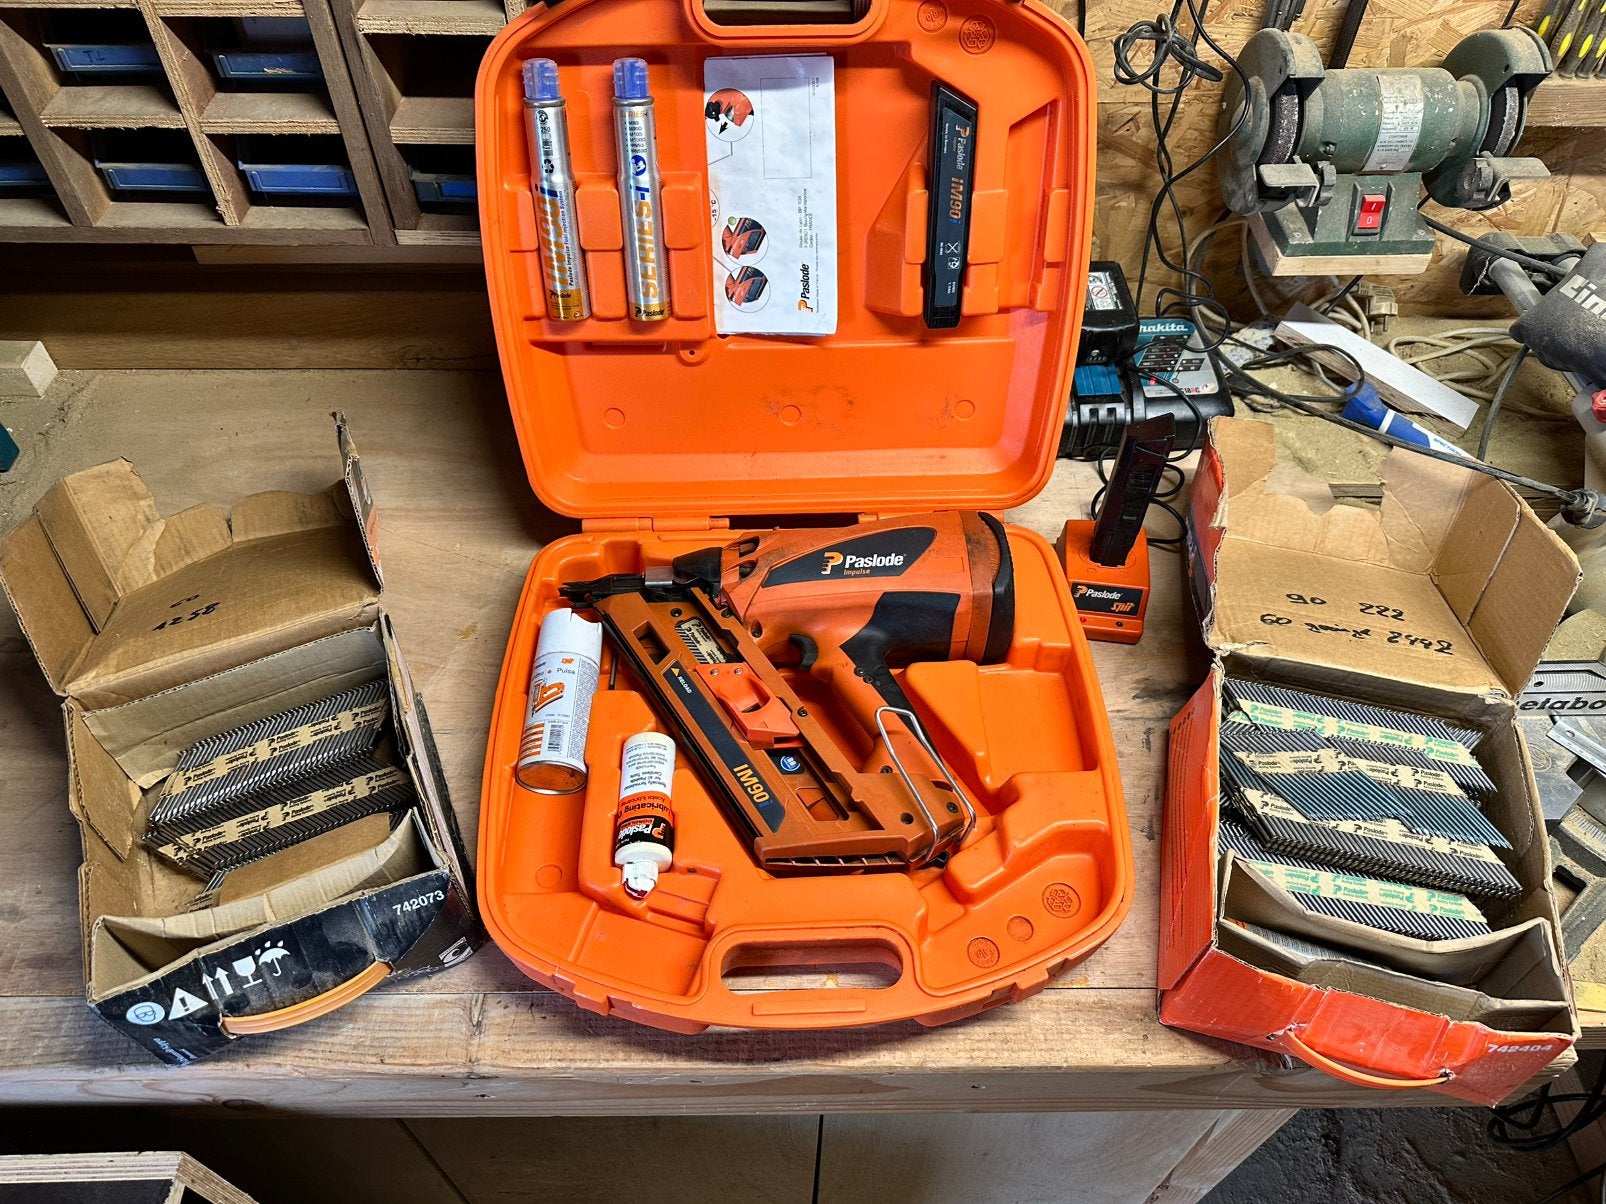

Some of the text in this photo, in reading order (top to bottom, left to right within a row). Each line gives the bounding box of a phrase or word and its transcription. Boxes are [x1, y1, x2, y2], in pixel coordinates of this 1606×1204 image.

[956, 137, 966, 170] Paslode
[950, 177, 964, 224] IM90i
[800, 264, 810, 299] Paslode
[642, 309, 665, 317] Paslode
[844, 553, 904, 568] Paslode
[843, 568, 871, 576] Impulse
[1086, 588, 1121, 600] Paslode
[1358, 602, 1405, 621] 222
[1259, 613, 1292, 626] 60
[677, 676, 692, 694] RELOAD
[1519, 697, 1606, 710] etabo
[733, 763, 774, 808] IM90i
[624, 802, 671, 816] Lubricating
[618, 824, 653, 840] Paslode
[392, 890, 445, 915] 742073
[1488, 1044, 1553, 1053] 742404
